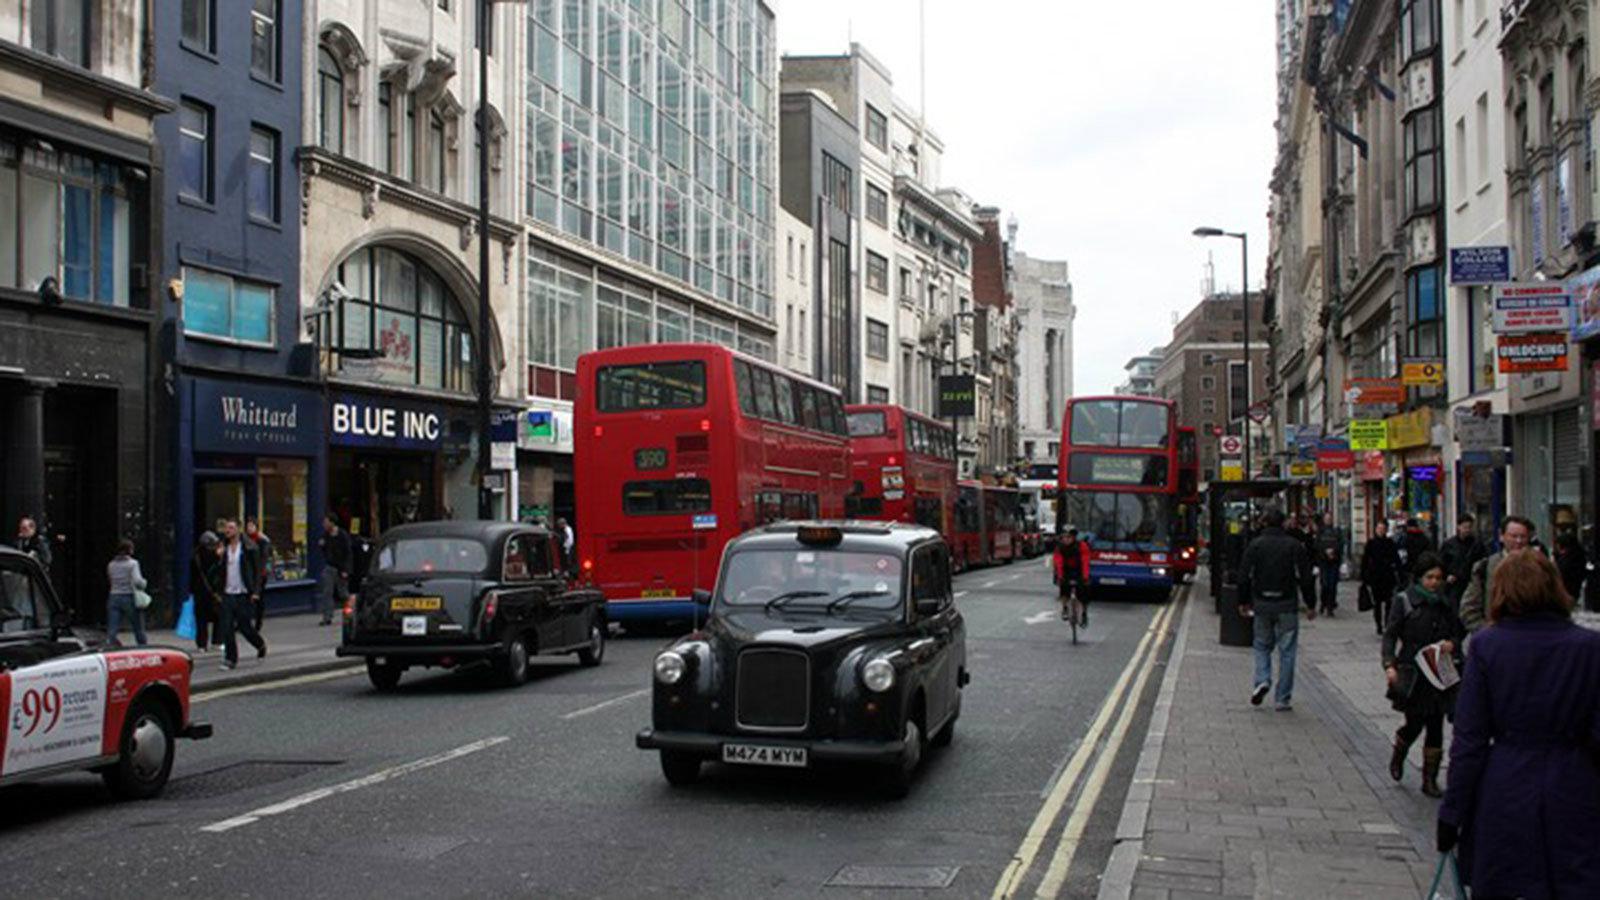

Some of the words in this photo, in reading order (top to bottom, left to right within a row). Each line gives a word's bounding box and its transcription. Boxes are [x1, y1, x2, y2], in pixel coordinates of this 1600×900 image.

[1500, 343, 1566, 356] UNLOCKING
[221, 397, 297, 428] Whittard
[333, 403, 396, 437] BLUE
[403, 410, 440, 440] INC
[637, 451, 666, 468] 390
[726, 745, 768, 761] M474
[772, 749, 804, 764] MYM
